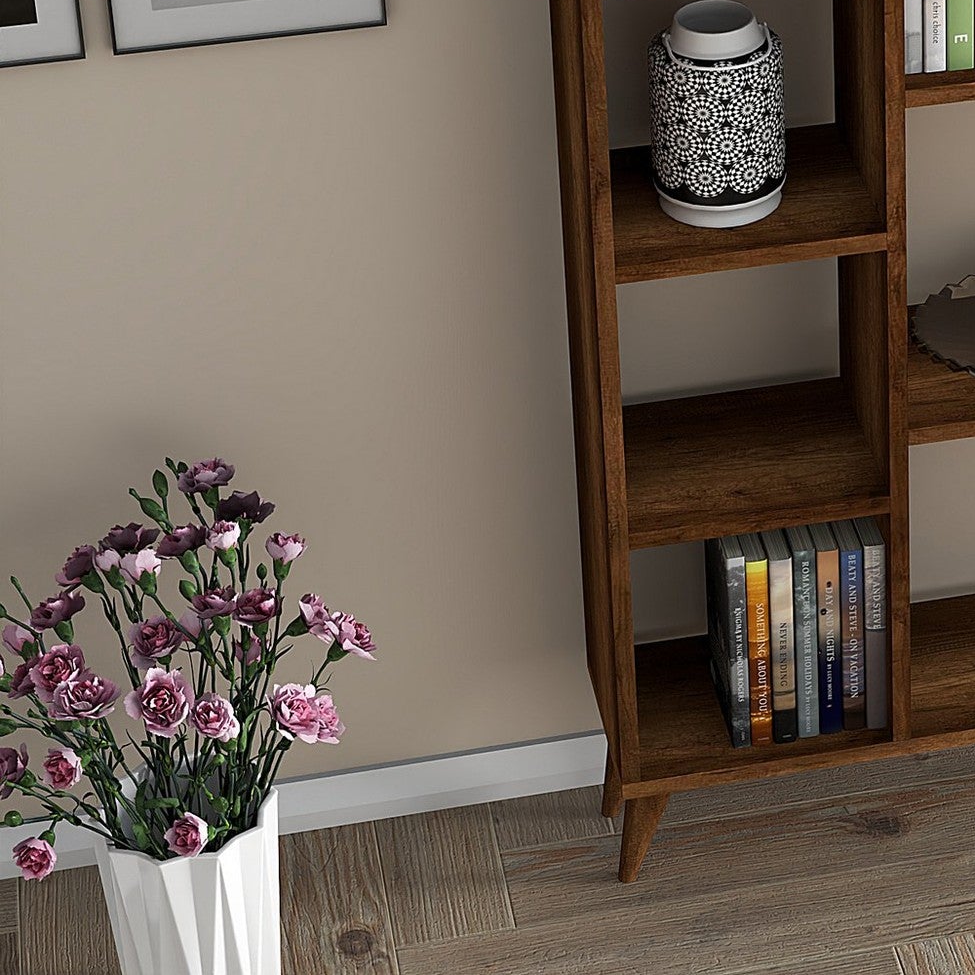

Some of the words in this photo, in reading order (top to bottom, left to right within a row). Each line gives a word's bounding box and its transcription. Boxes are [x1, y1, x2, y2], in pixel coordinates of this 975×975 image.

[932, 1, 940, 19] chris
[932, 21, 940, 43] choice
[848, 555, 857, 582] BEATY
[873, 550, 881, 578] BEATY
[825, 587, 833, 605] DAY
[848, 584, 857, 603] AND
[873, 582, 881, 601] AND
[825, 608, 834, 627] AND
[849, 604, 857, 631] STEVE
[873, 603, 881, 629] STEVE
[756, 603, 766, 657] SOMETHING
[779, 623, 787, 651] NEVER
[803, 621, 811, 654] SUMMER
[826, 630, 835, 662] NIGHTS
[850, 639, 858, 651] ON
[736, 644, 744, 676] NICHOLAS
[779, 653, 788, 687] ENDING
[758, 659, 767, 689] ABOUT
[804, 656, 812, 695] HOLIDAYS
[850, 654, 858, 698] VACATION
[737, 678, 745, 702] ROGERS
[758, 692, 768, 712] YOU
